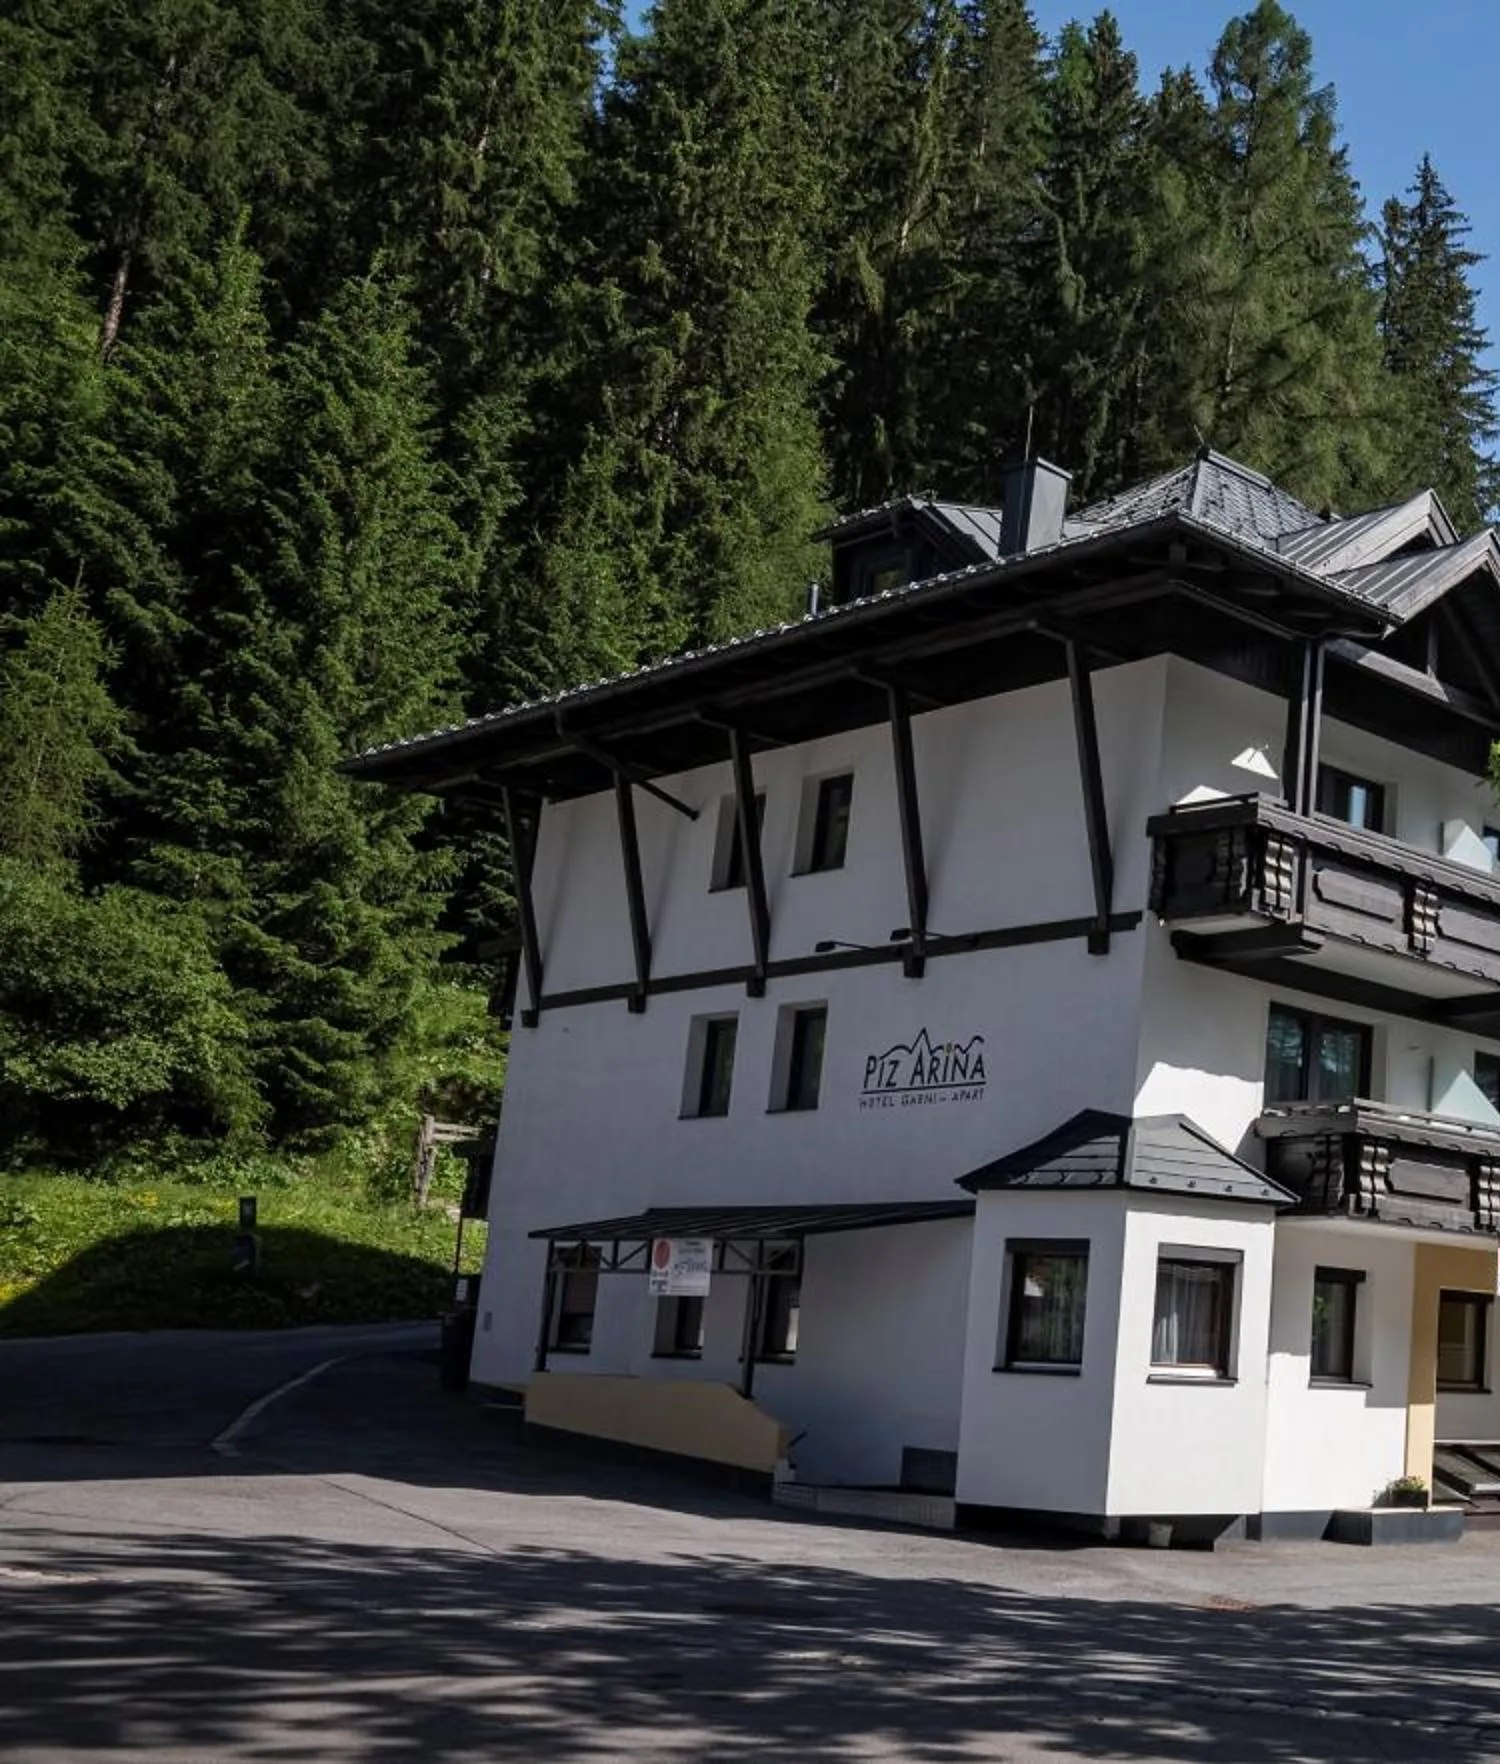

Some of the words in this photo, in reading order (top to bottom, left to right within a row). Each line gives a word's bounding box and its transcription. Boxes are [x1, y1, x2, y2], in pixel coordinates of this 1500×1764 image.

[864, 1056, 899, 1088] PIZ
[910, 1051, 986, 1086] ARINA
[859, 1095, 895, 1110] HOTEL
[901, 1092, 937, 1106] GARNI
[951, 1087, 985, 1101] APART
